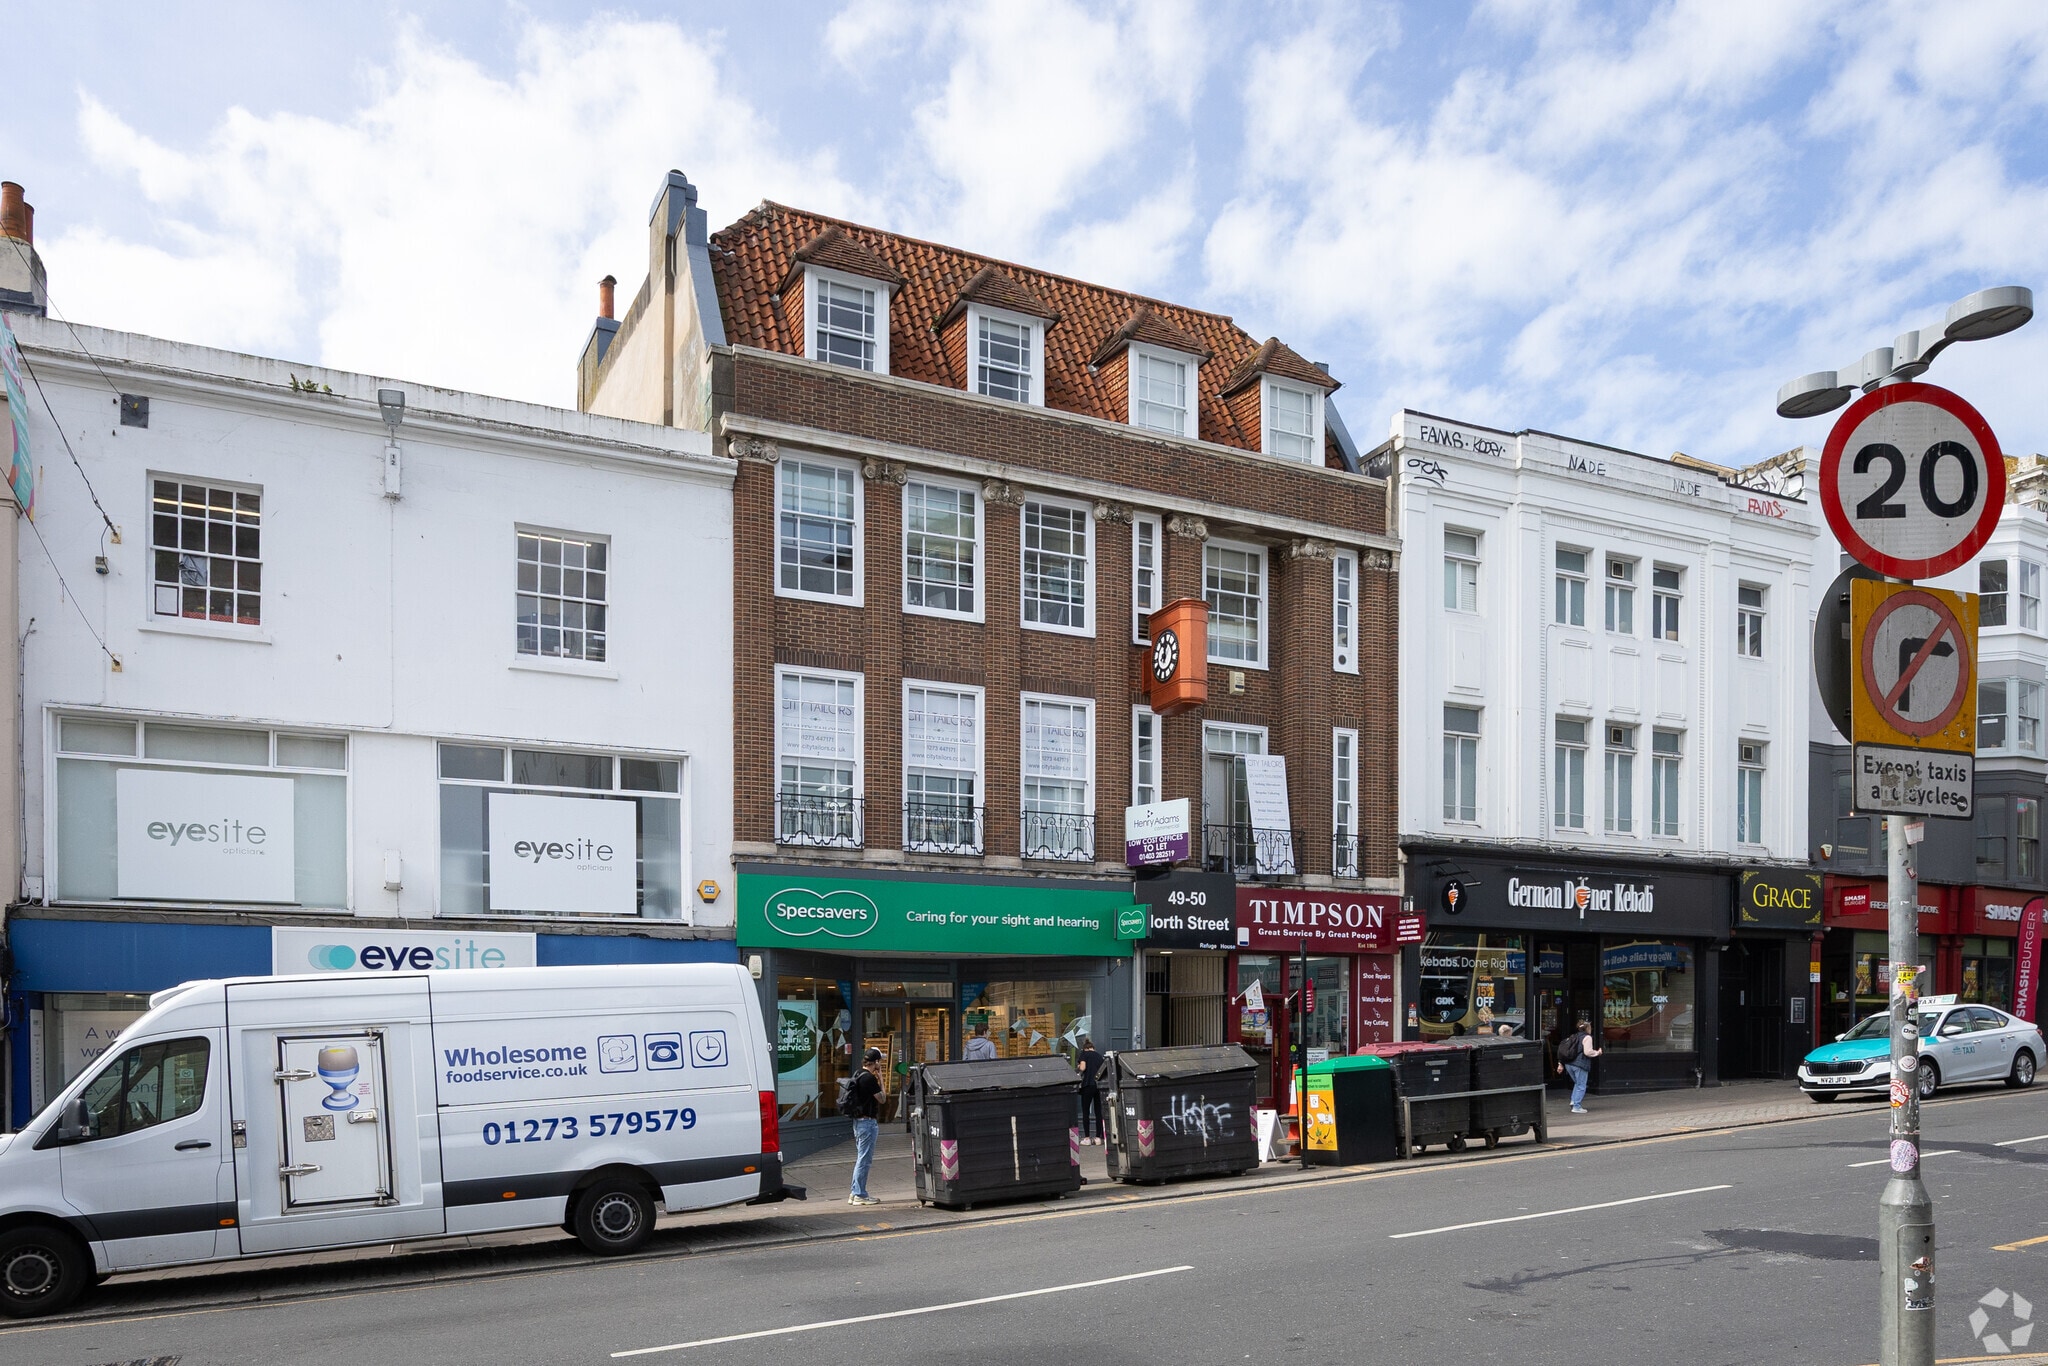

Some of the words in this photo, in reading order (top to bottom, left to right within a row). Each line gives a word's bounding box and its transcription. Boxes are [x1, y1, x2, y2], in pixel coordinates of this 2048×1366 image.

[1853, 440, 1978, 520] 20
[1928, 762, 1967, 782] taxis
[147, 819, 266, 846] eyesite
[1159, 834, 1183, 842] OFFICES
[514, 838, 613, 863] eyesite
[1156, 843, 1167, 851] LET
[577, 864, 612, 872] opticians
[1168, 891, 1206, 906] 49-50
[1508, 877, 1562, 909] German
[1753, 884, 1811, 909] GRACE
[776, 903, 868, 920] Specsavers
[906, 911, 946, 925] Caring
[950, 912, 968, 924] for
[971, 916, 999, 926] your
[1001, 913, 1031, 927] sight
[1033, 914, 1054, 927] and
[1057, 916, 1099, 930] hearing
[1249, 900, 1385, 928] TIMPSON
[1151, 914, 1183, 929] orth
[1187, 916, 1230, 931] Street
[1258, 928, 1281, 936] Great
[1283, 929, 1313, 937] Service
[1315, 931, 1326, 939] By
[1328, 931, 1349, 939] Great
[1352, 932, 1377, 940] People
[360, 939, 506, 971] eyesite
[1420, 956, 1460, 967] Kebabs.
[1461, 957, 1488, 968] Done
[1490, 958, 1518, 970] Right.
[2016, 912, 2036, 1018] SMASHBURGER
[1477, 986, 1495, 997] 15%
[1435, 997, 1455, 1005] GDK
[1476, 997, 1495, 1007] OFF
[85, 1027, 98, 1039] A
[444, 1045, 587, 1067] Wholesome
[1962, 1046, 1976, 1054] TAXI
[446, 1064, 588, 1083] foodservice.co.uk
[483, 1116, 579, 1146] 01273
[589, 1108, 697, 1137] 579579
